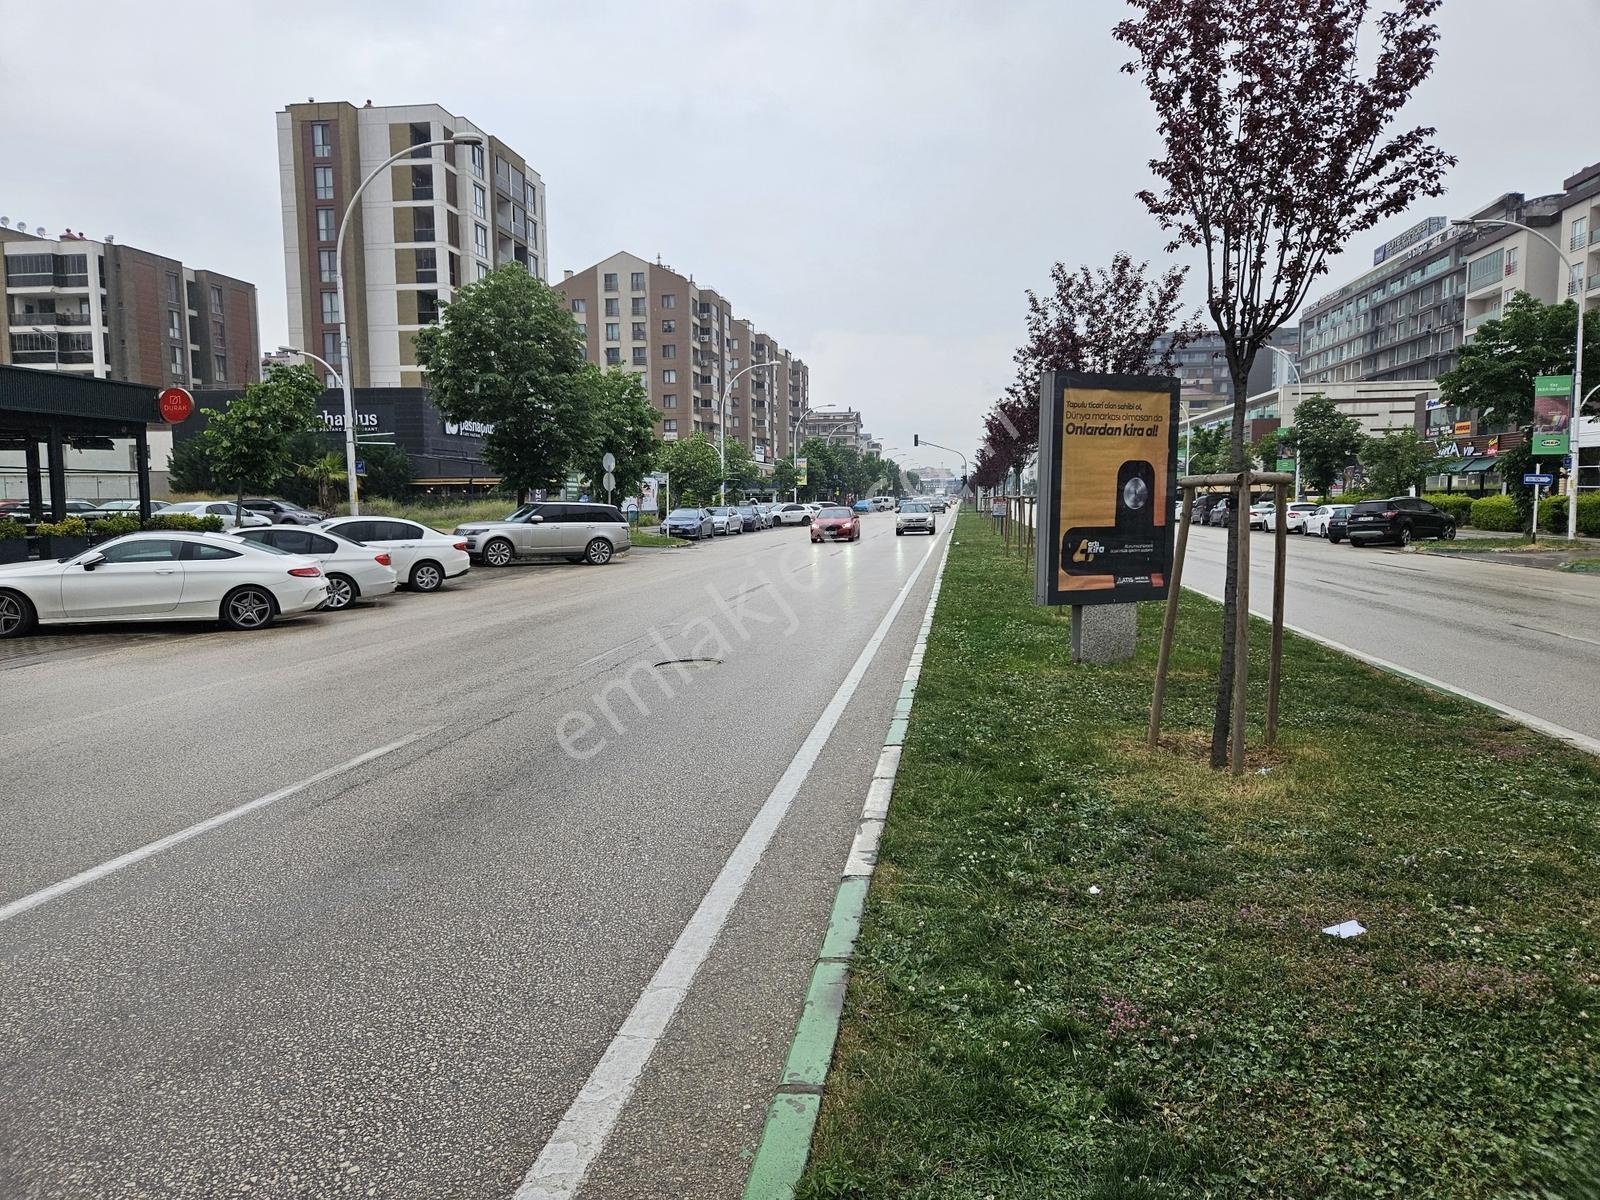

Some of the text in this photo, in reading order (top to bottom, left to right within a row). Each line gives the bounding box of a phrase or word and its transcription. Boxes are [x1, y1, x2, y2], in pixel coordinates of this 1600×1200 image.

[1066, 400, 1088, 409] Tapulu
[1088, 401, 1104, 409] ticari
[1066, 411, 1091, 421] Dünya
[1092, 412, 1120, 421] markası
[1122, 414, 1153, 422] olmasan
[1066, 422, 1159, 437] Onlardan kira al!
